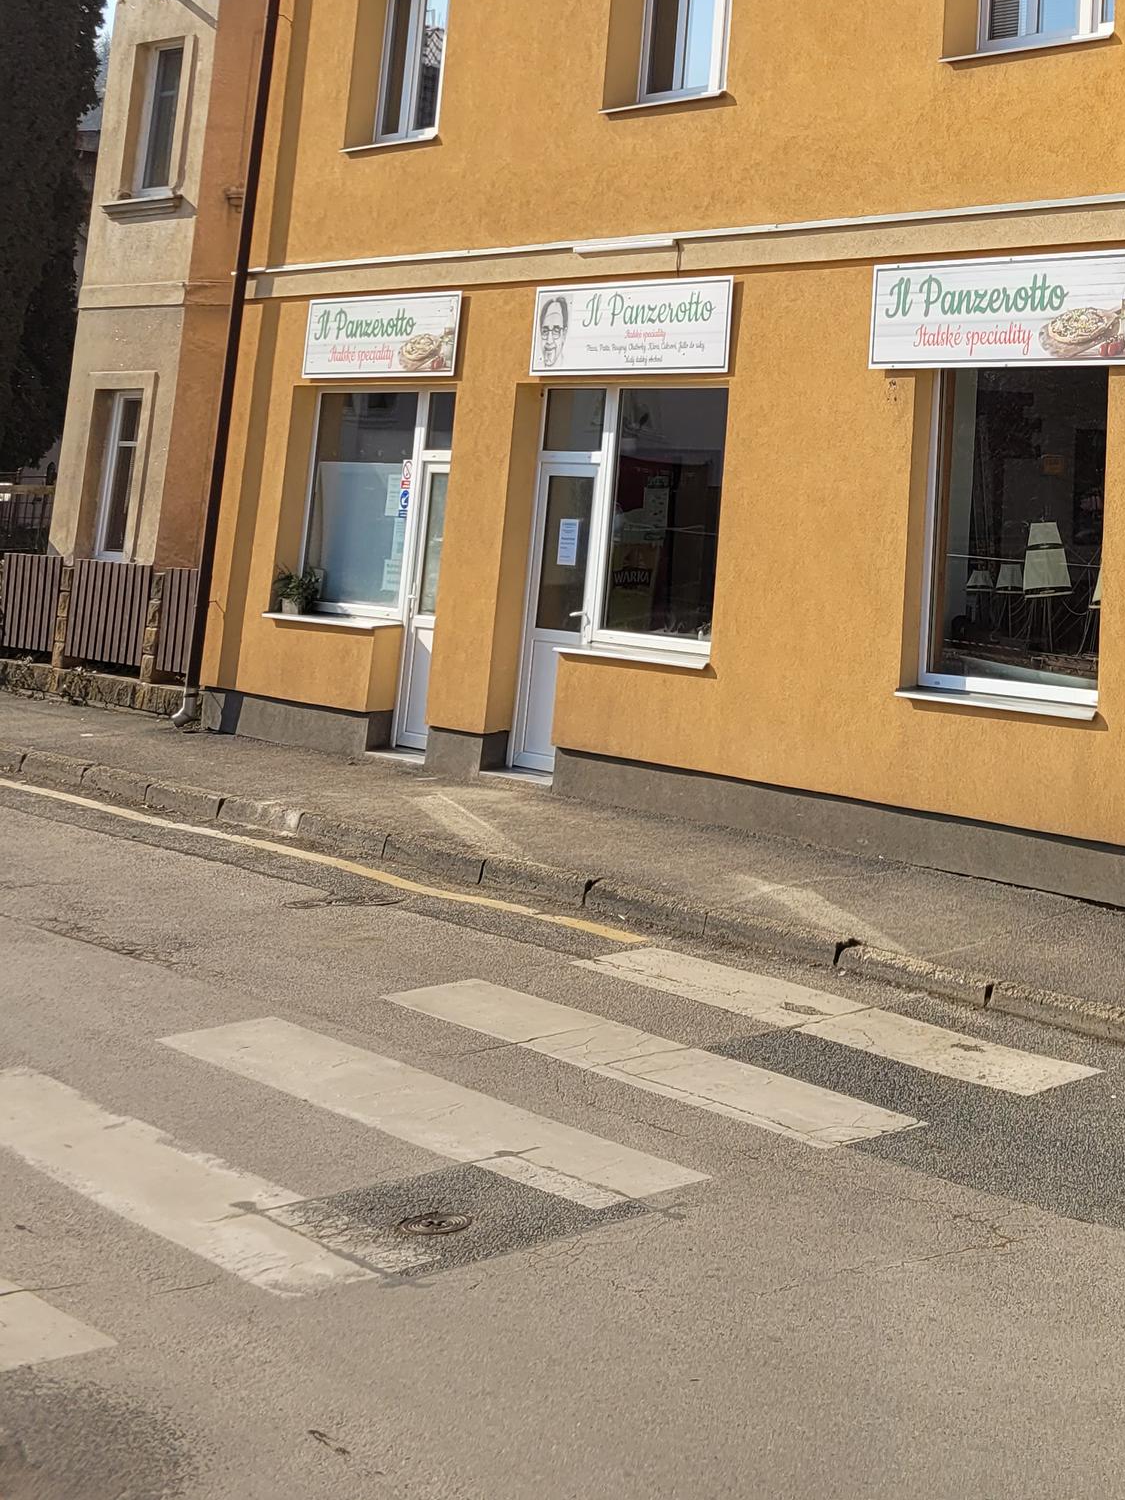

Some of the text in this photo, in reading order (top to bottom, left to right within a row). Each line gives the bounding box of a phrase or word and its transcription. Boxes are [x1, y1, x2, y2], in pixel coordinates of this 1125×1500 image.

[582, 291, 716, 327] Il Panzerotto
[885, 274, 1069, 319] Il Panzerotto
[314, 307, 416, 341] Il Panzerotto
[912, 322, 1033, 356] Italské speciality
[614, 571, 649, 584] WARKA
